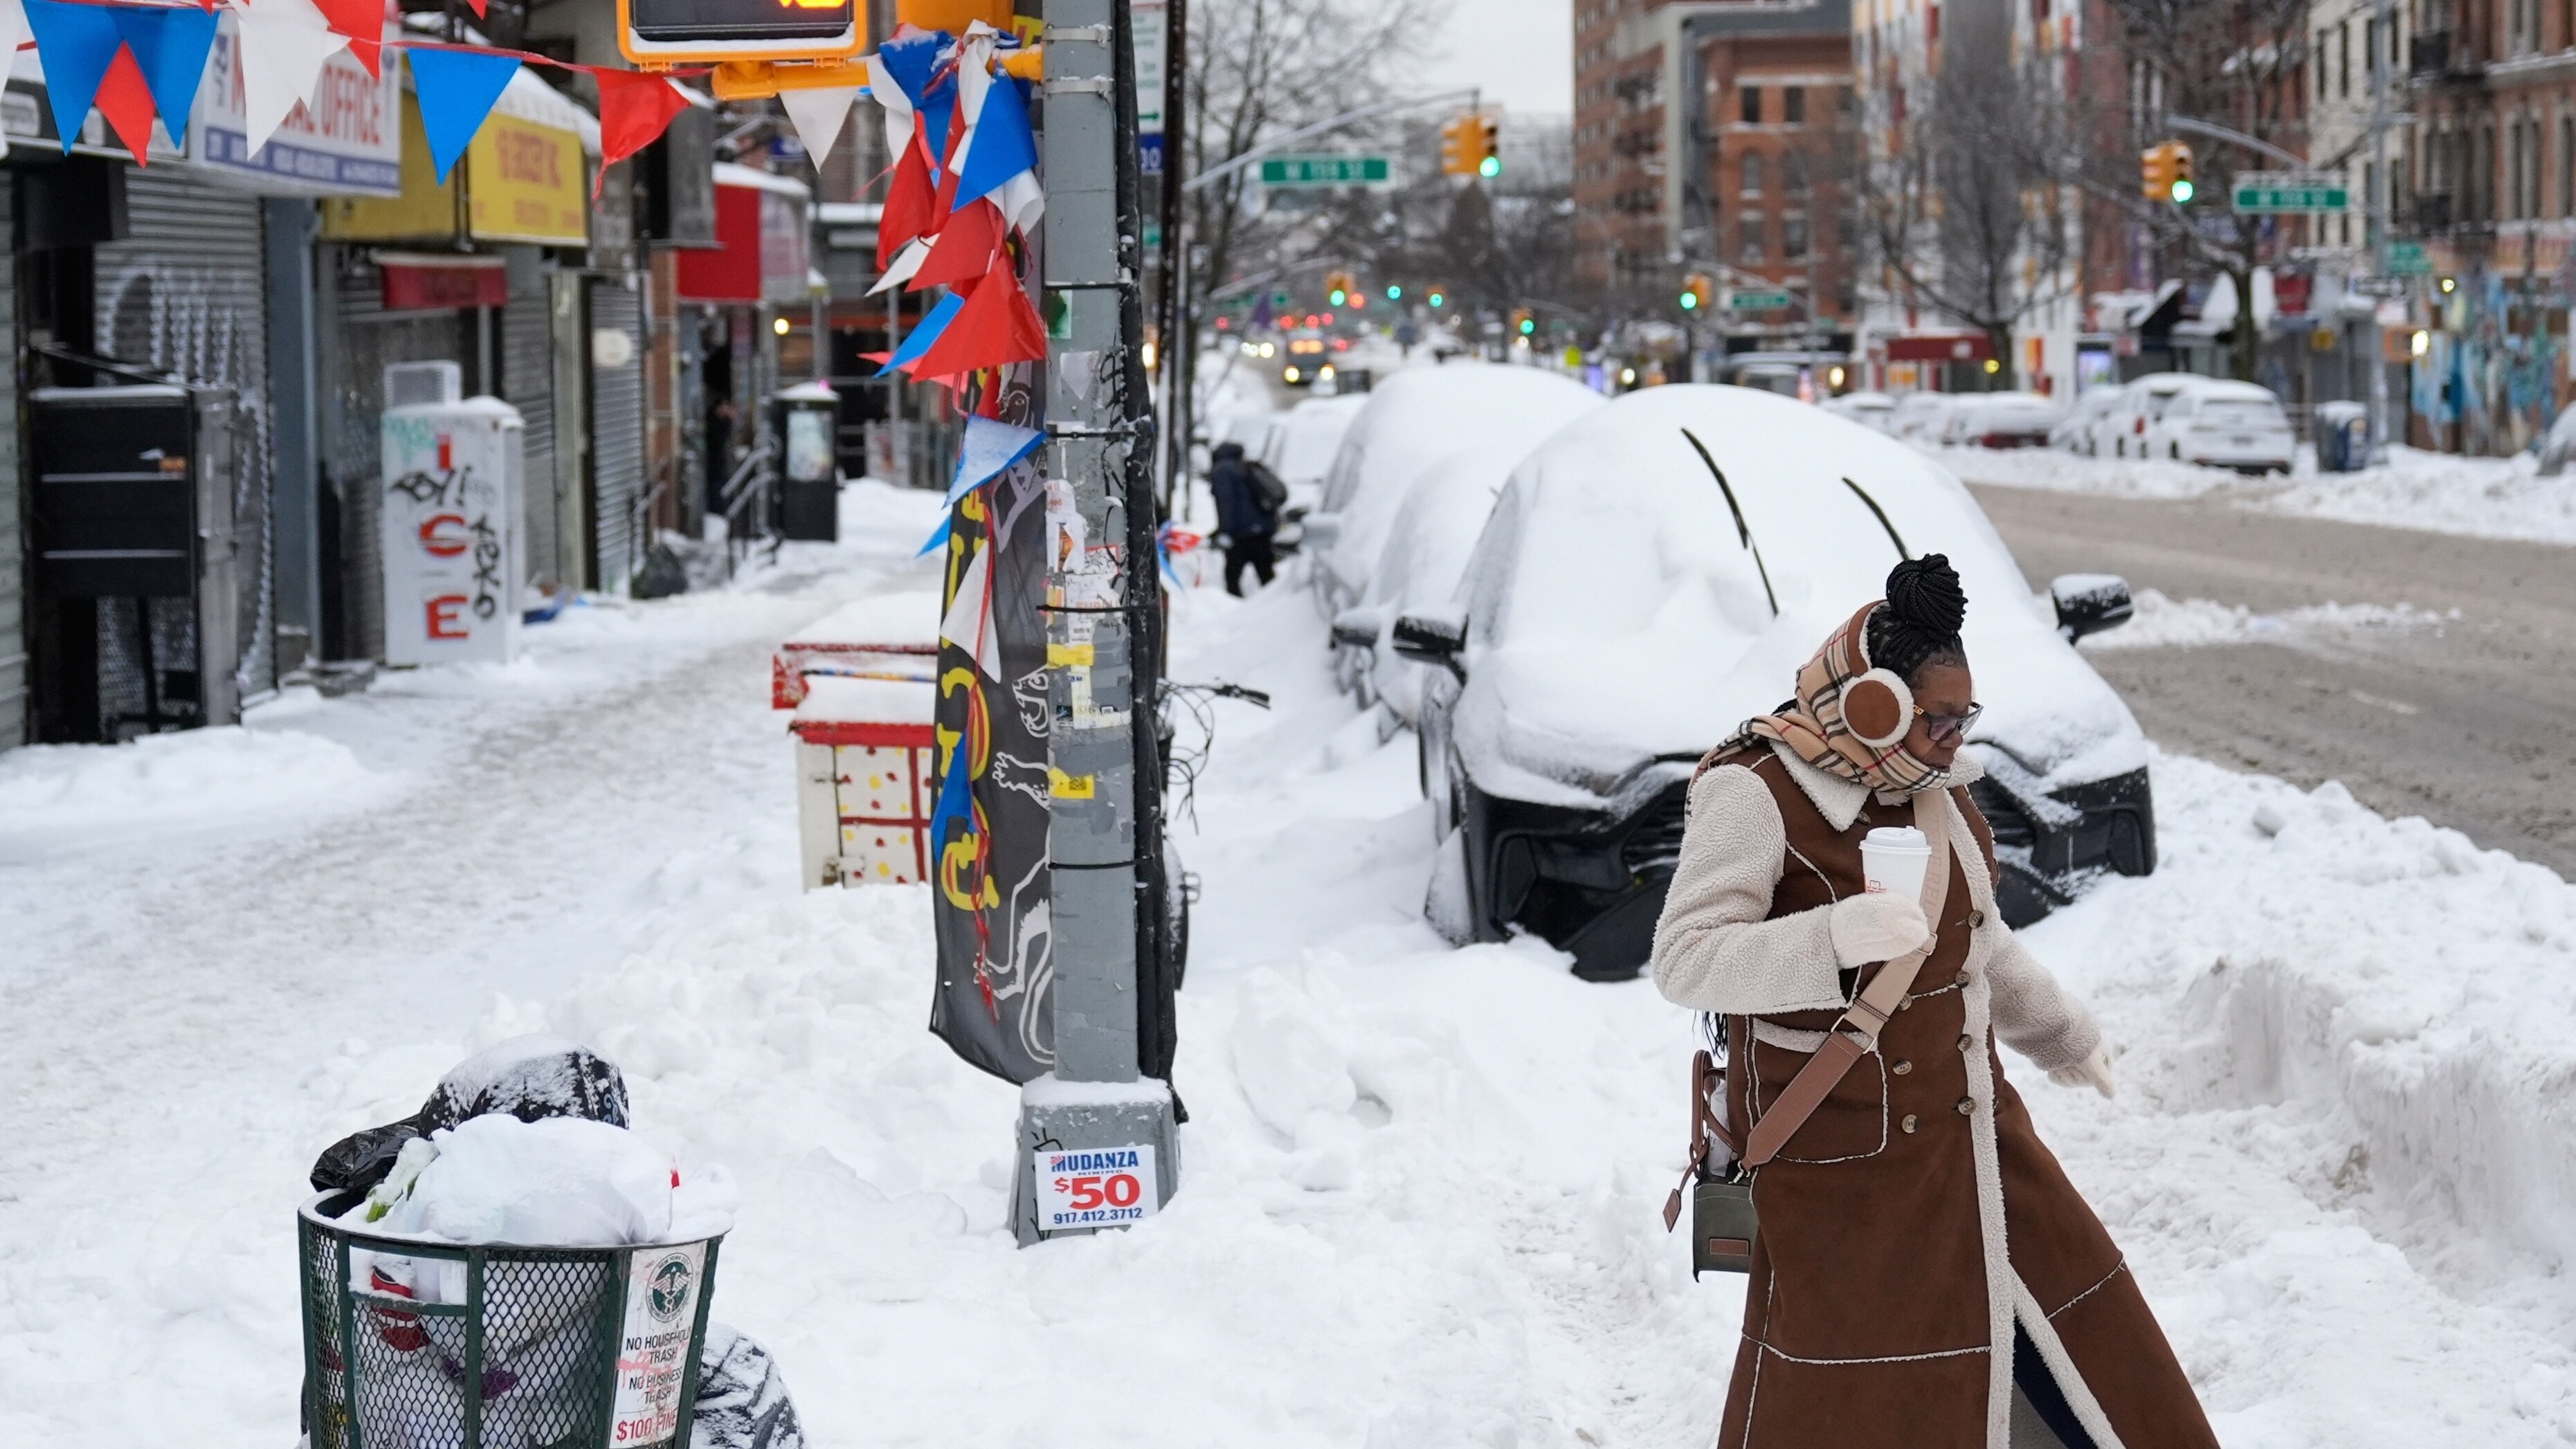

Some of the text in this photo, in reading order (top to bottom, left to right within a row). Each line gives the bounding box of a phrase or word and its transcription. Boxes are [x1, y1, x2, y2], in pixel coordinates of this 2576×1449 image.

[323, 63, 380, 147] OFFICE
[1051, 1151, 1139, 1172] MUDANZA
[1053, 1174, 1141, 1210] $50
[1053, 1208, 1143, 1224] 917.412.3712
[626, 1337, 642, 1351] NO
[649, 1347, 678, 1365] TRASH
[628, 1376, 644, 1390] NO
[616, 1407, 678, 1443] $100 FINE
